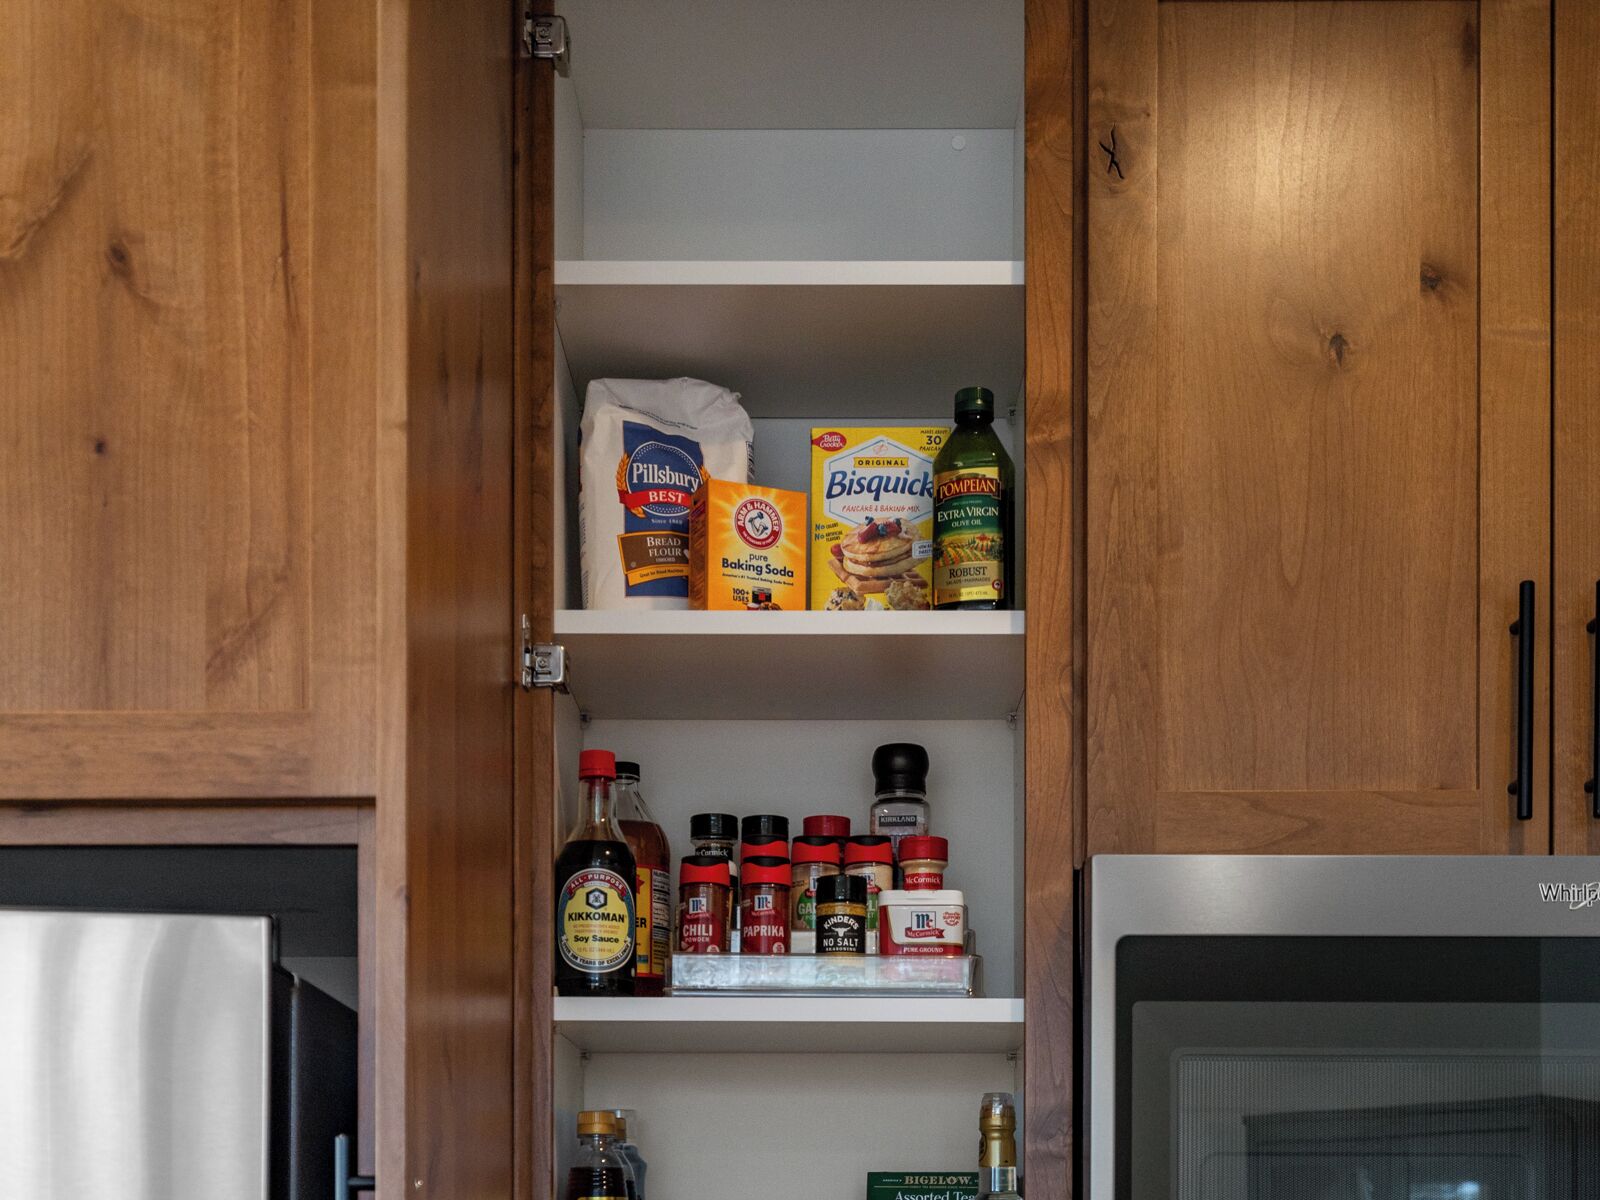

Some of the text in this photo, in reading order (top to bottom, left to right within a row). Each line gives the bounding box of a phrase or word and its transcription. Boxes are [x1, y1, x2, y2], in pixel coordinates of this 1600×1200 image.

[926, 435, 942, 446] 30
[632, 462, 699, 493] Pillsbury
[826, 469, 934, 502] Bisquick
[939, 479, 996, 499] POMPEIAN
[648, 490, 685, 504] BEST
[841, 504, 873, 513] PANCAKE
[906, 504, 920, 512] MIX
[737, 507, 748, 527] ARM
[753, 501, 780, 532] HAMMER
[937, 506, 999, 522] EXTRA VIRGIN
[814, 523, 825, 531] No
[951, 518, 982, 528] OLIVE OIL
[646, 536, 681, 547] BREAD
[814, 533, 825, 542] No
[648, 547, 682, 557] FLOUR
[749, 553, 768, 562] pure
[721, 557, 794, 578] Baking Soda
[949, 566, 988, 579] ROBUST
[732, 595, 750, 603] USES
[880, 815, 916, 823] KIRKLAND
[905, 875, 941, 884] McCormick
[1538, 882, 1600, 909] Whirlp
[568, 911, 625, 924] KIKKOMAN
[682, 923, 713, 937] CHILI
[743, 924, 785, 938] PAPRIKA
[906, 928, 940, 937] McCormick
[573, 934, 620, 944] Soy Sauce
[823, 937, 859, 947] NO SALT
[578, 956, 597, 966] YEARS
[904, 1175, 972, 1185] BIGELOW
